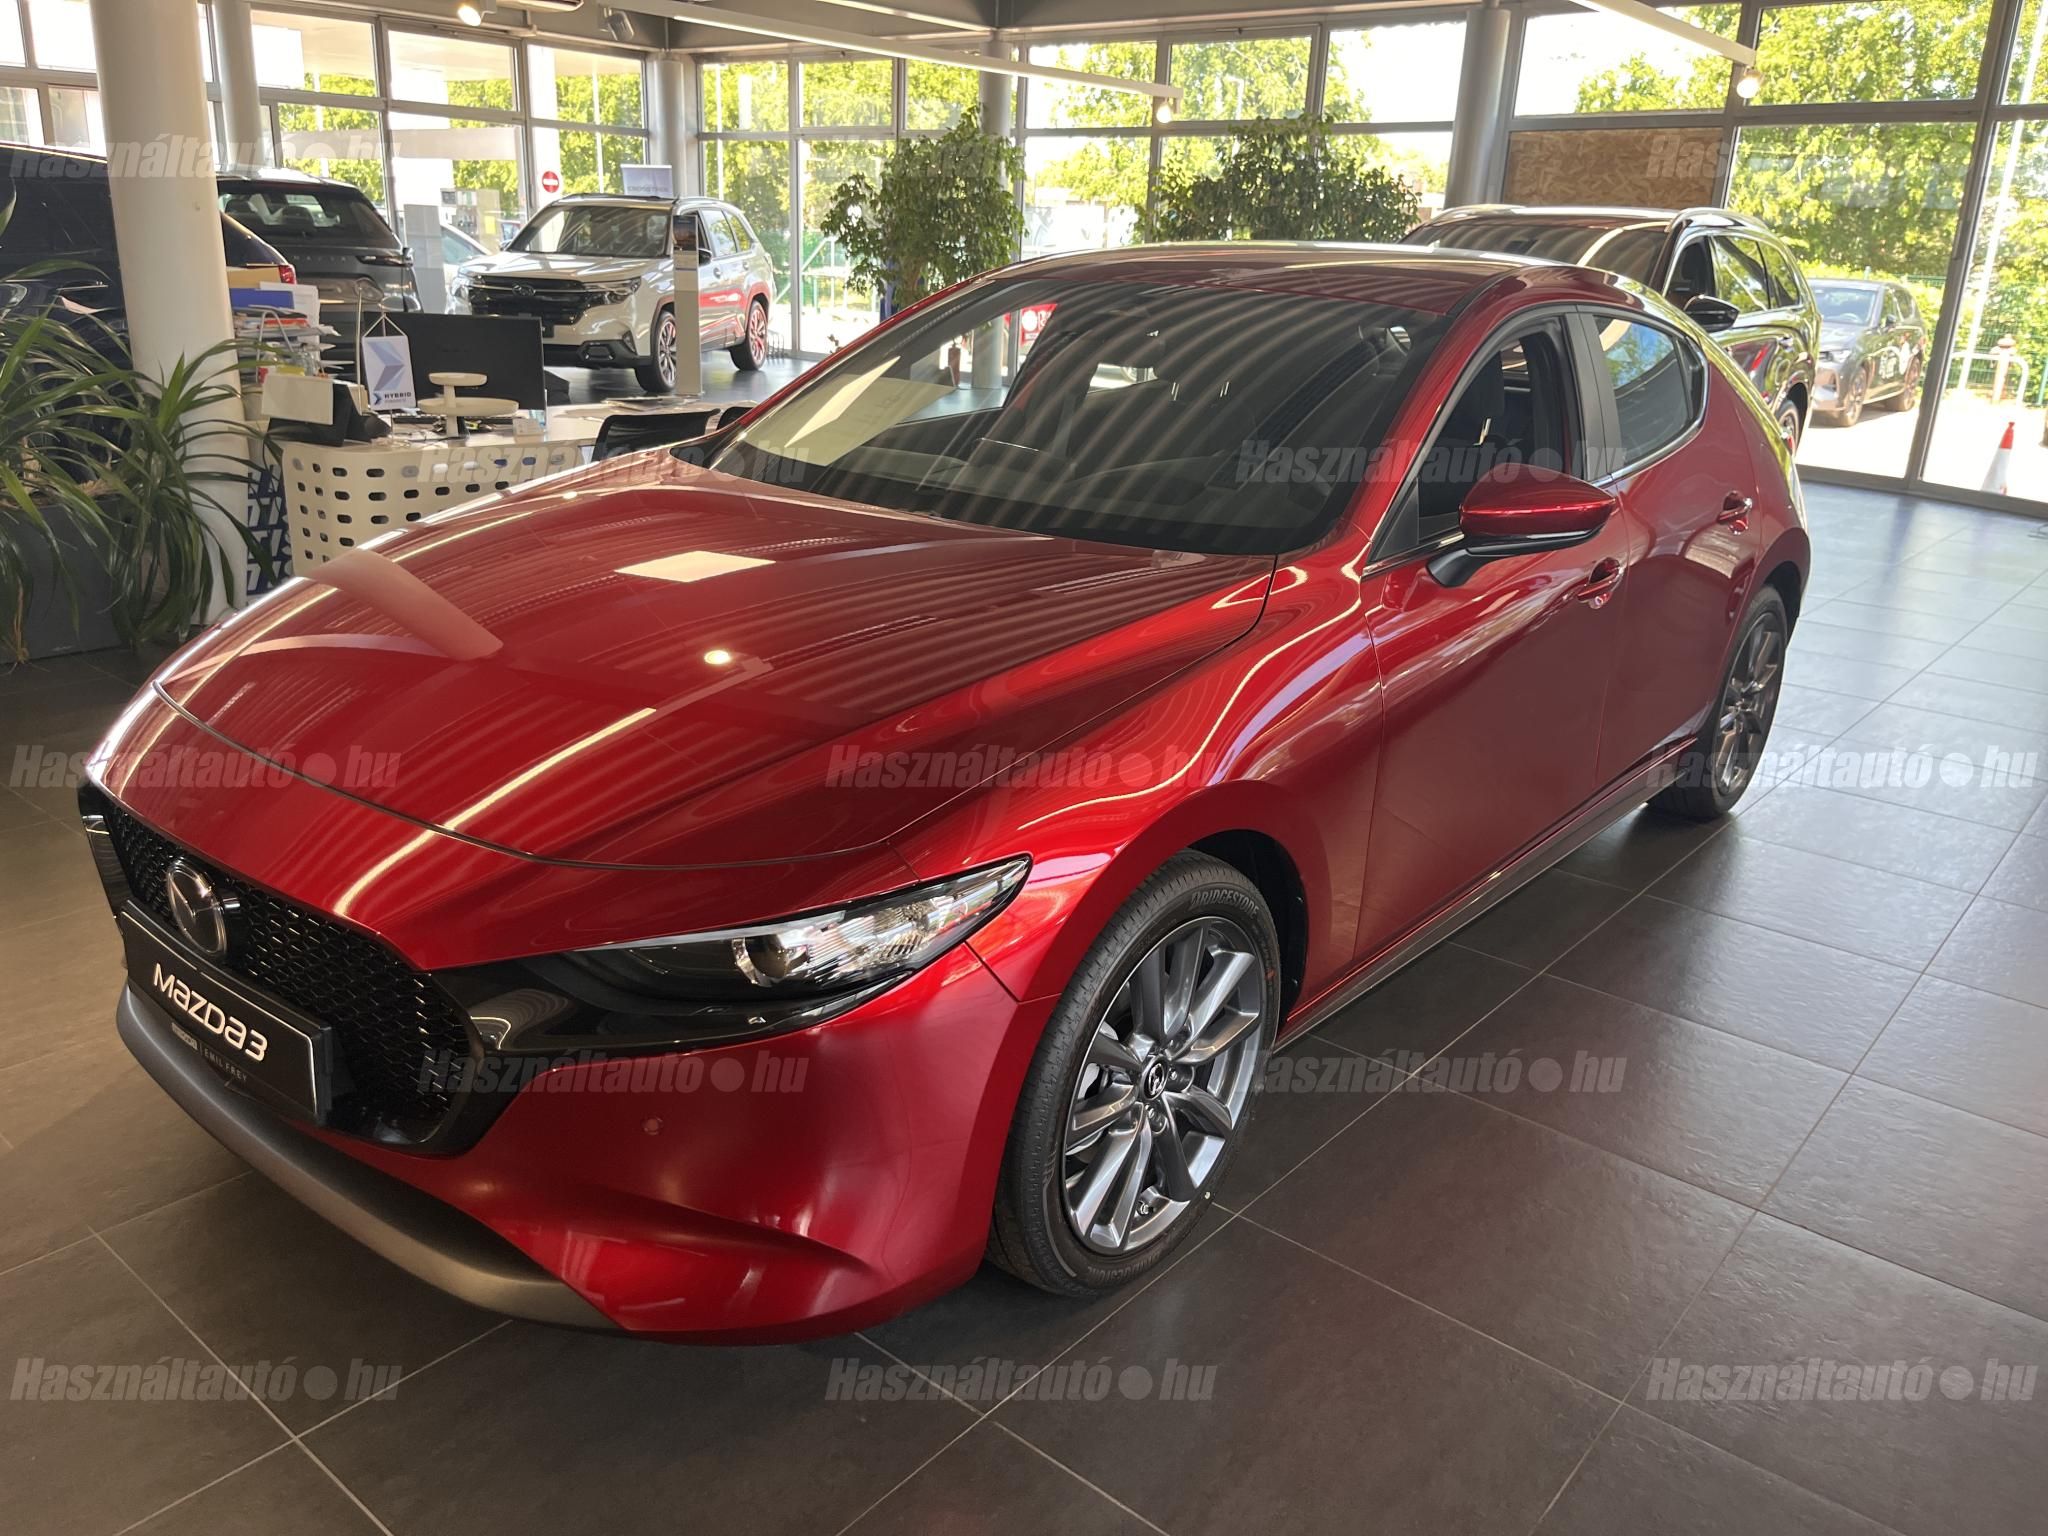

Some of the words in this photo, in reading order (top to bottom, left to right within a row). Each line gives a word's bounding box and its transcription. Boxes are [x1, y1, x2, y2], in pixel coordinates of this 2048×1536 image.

[384, 391, 412, 399] HYBRID
[204, 1048, 223, 1067] EMIL
[225, 1062, 247, 1081] FREY
